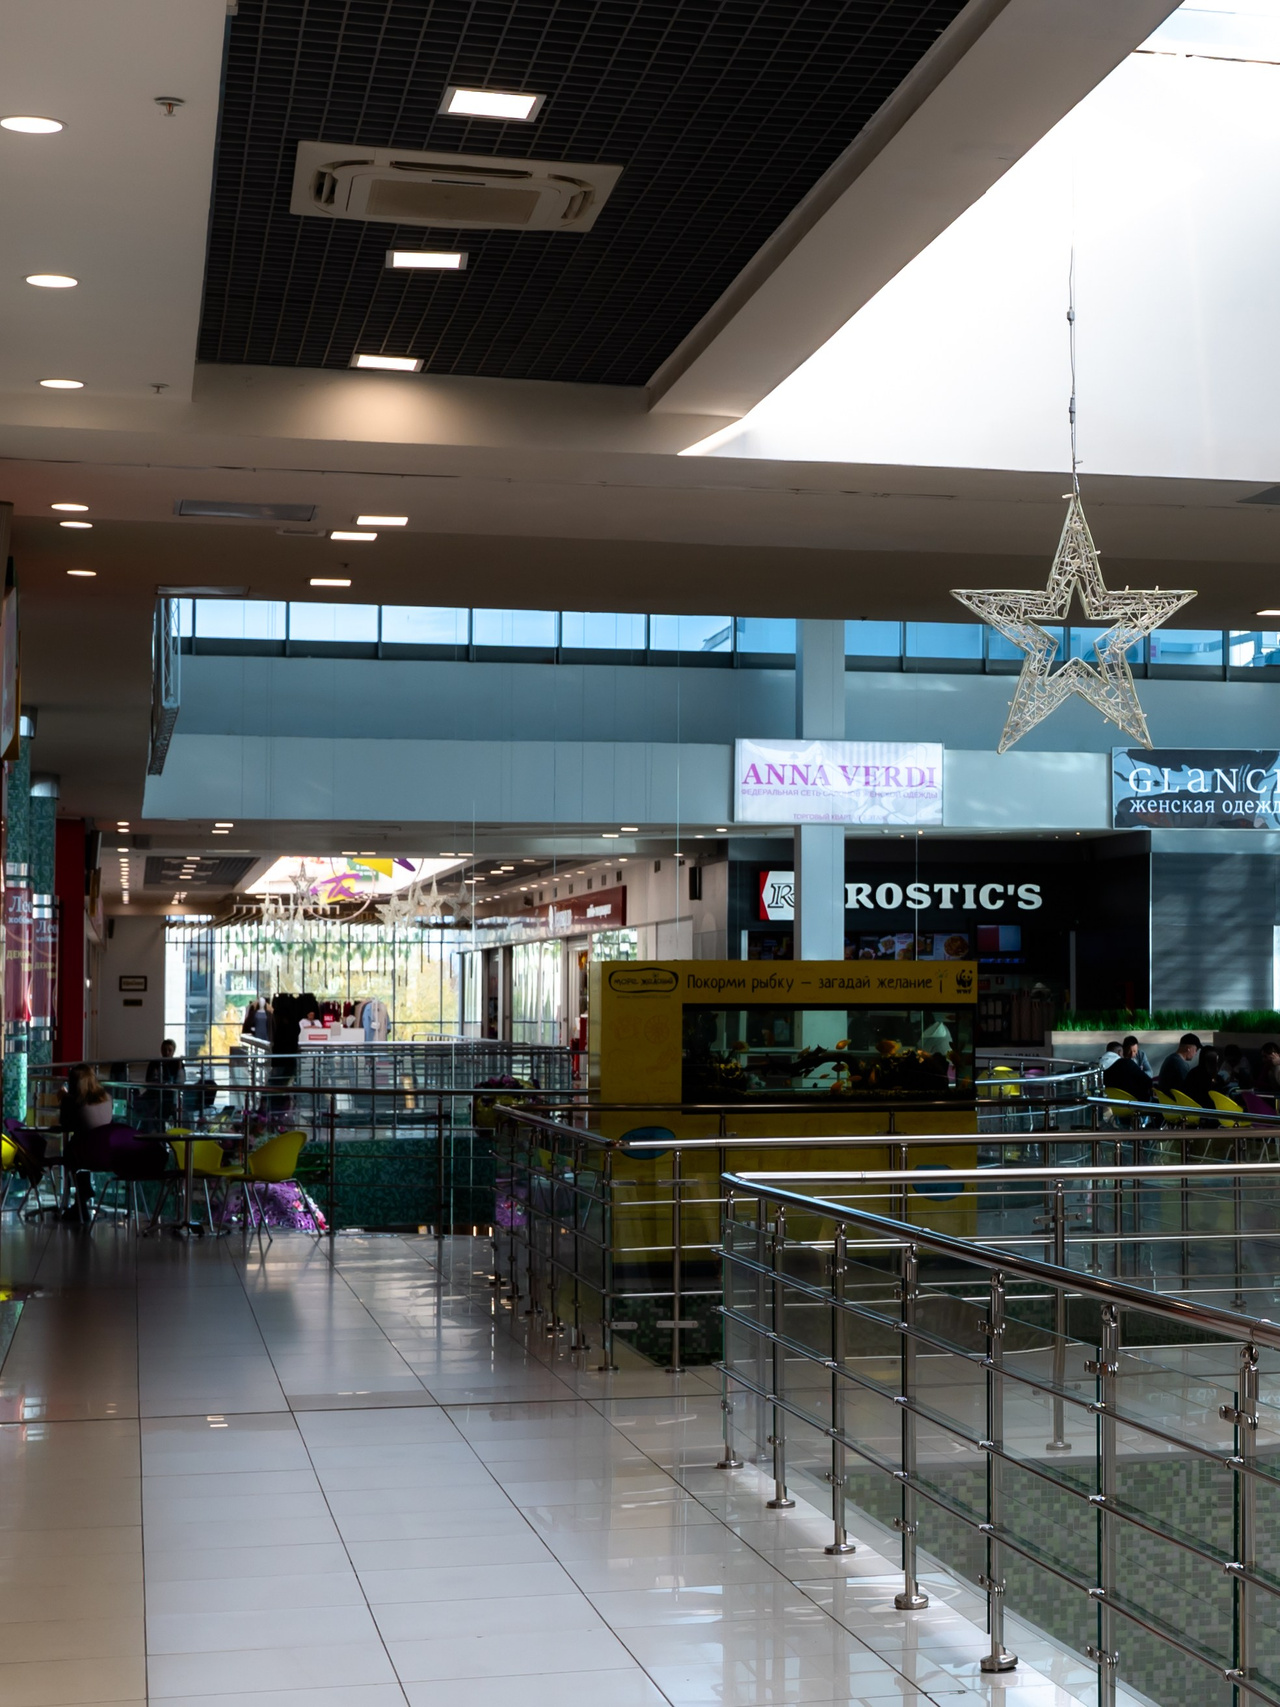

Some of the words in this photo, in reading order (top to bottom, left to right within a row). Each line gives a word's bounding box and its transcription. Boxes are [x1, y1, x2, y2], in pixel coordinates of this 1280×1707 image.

[741, 763, 831, 786] ANNA
[838, 765, 937, 788] VERDI
[741, 788, 799, 797] ФЕДЕРАЛЬНАЯ
[1129, 799, 1215, 814] женская
[845, 882, 1043, 910] ROSTIC'S
[687, 974, 746, 994] Покорми
[752, 972, 794, 995] рыбку
[818, 974, 871, 991] загадай
[877, 975, 933, 990] желание
